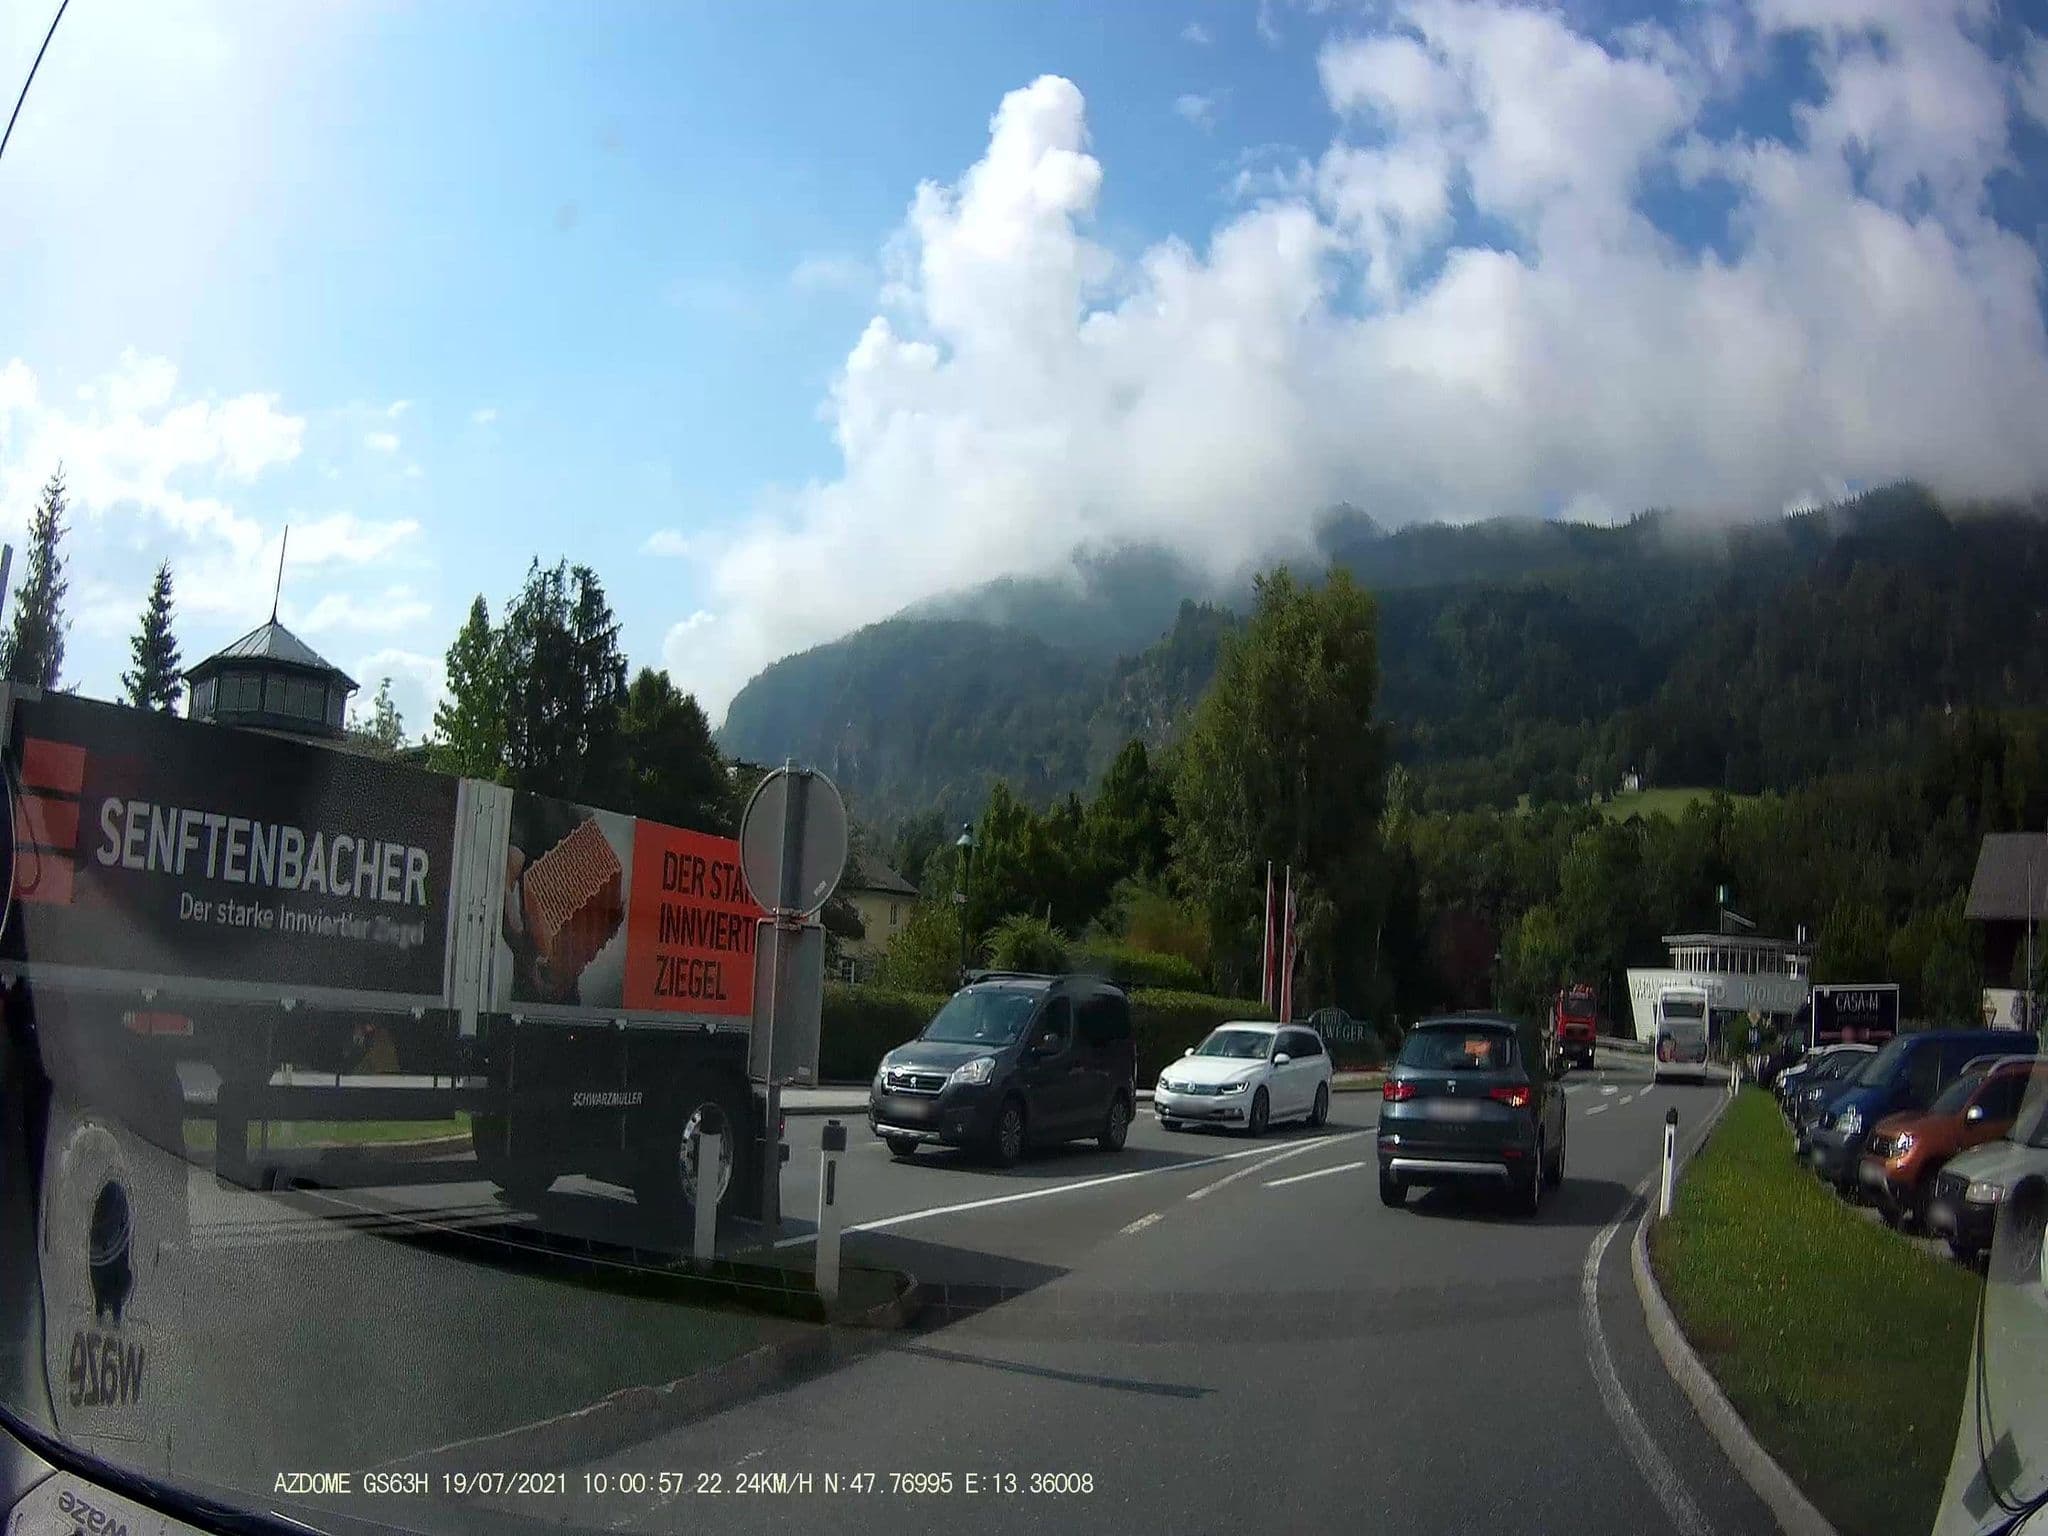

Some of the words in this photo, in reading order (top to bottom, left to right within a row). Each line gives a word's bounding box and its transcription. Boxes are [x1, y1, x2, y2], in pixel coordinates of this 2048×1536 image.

[97, 797, 430, 905] SENFTENBACHER
[662, 850, 706, 896] DER
[180, 892, 211, 922] Der
[217, 899, 273, 929] starke
[654, 954, 727, 1001] ZIEGEL
